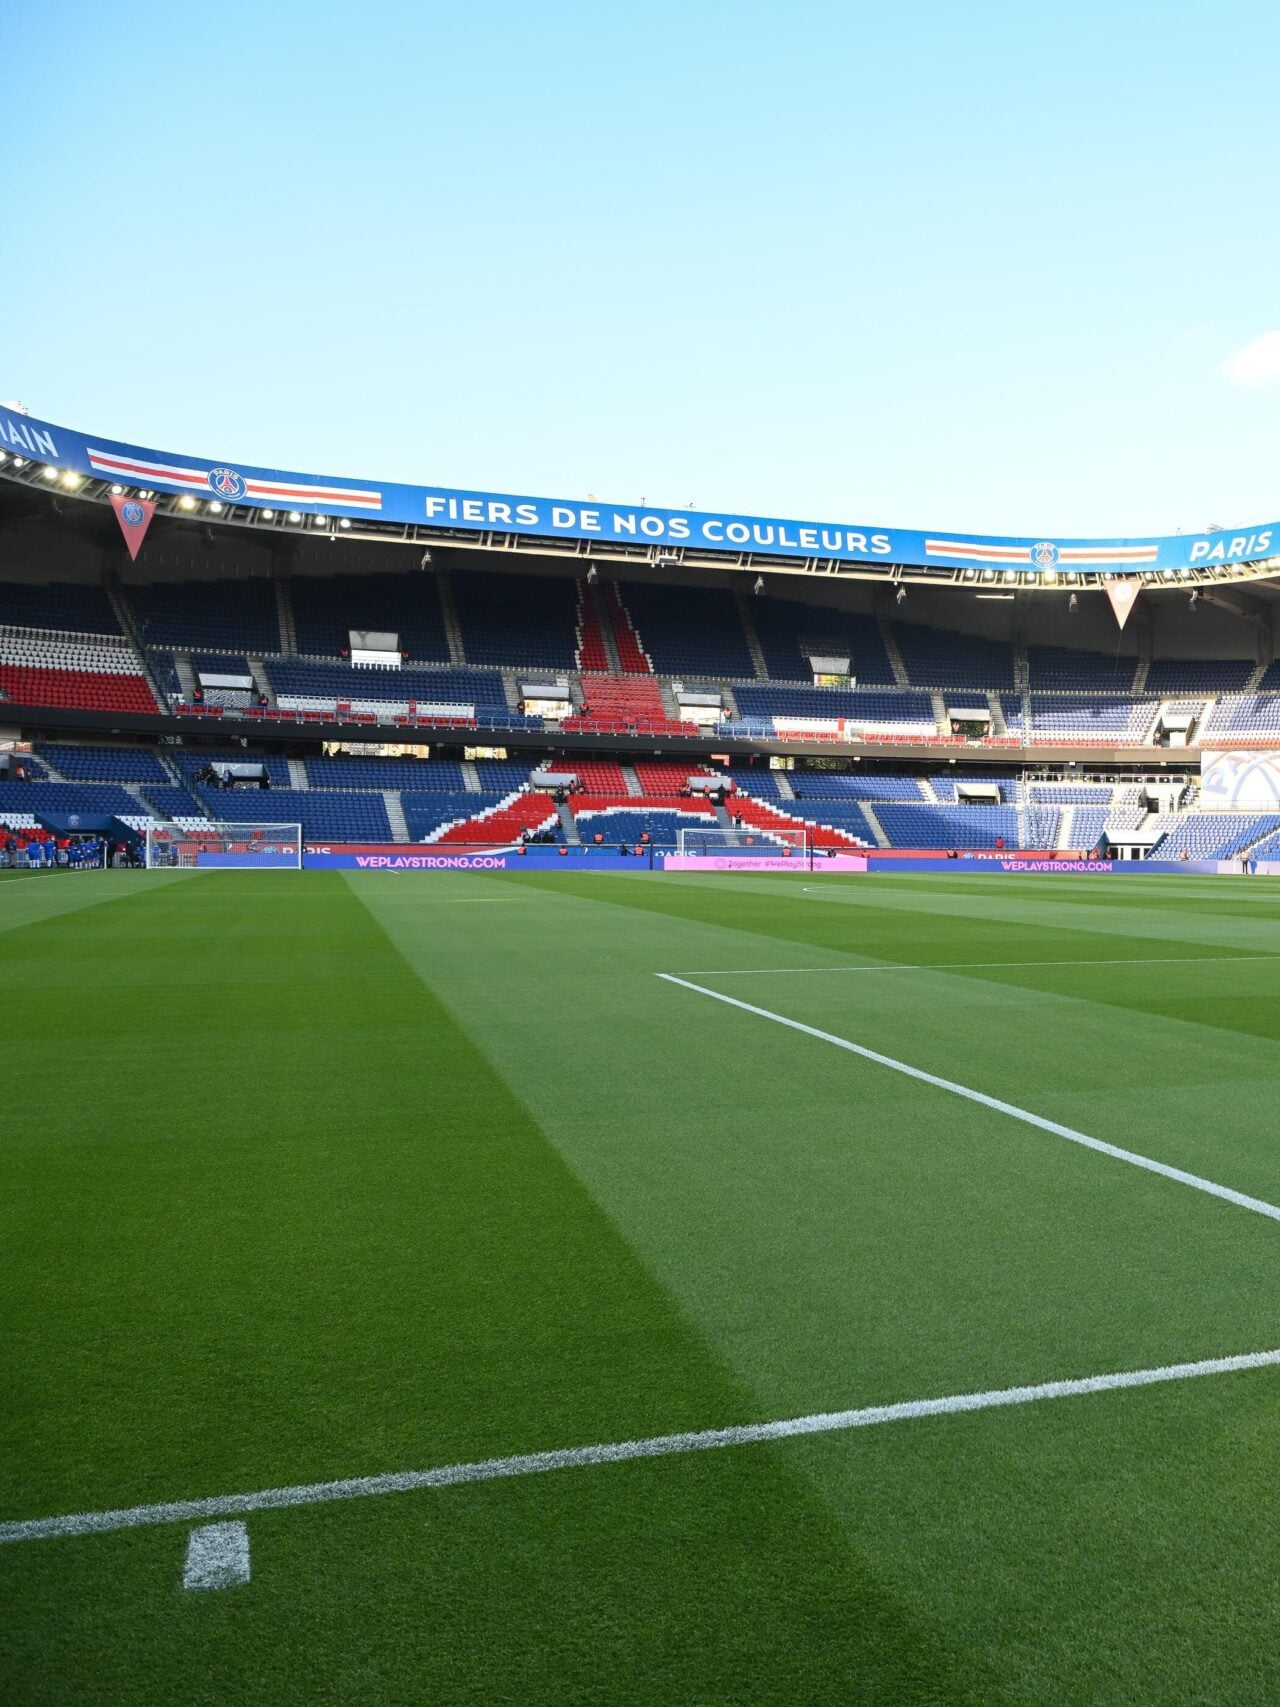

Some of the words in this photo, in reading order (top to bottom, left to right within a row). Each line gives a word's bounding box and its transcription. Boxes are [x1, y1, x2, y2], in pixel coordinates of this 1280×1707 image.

[425, 496, 539, 526] FIERS
[552, 507, 602, 532] DE
[613, 513, 690, 539] NOS
[702, 520, 892, 555] COULEURS
[1189, 531, 1273, 562] PARIS
[356, 856, 506, 869] WEPLAYSTRONG.COM
[728, 860, 762, 869] Together
[1001, 861, 1113, 871] WEPLAYSTRONG.COM
